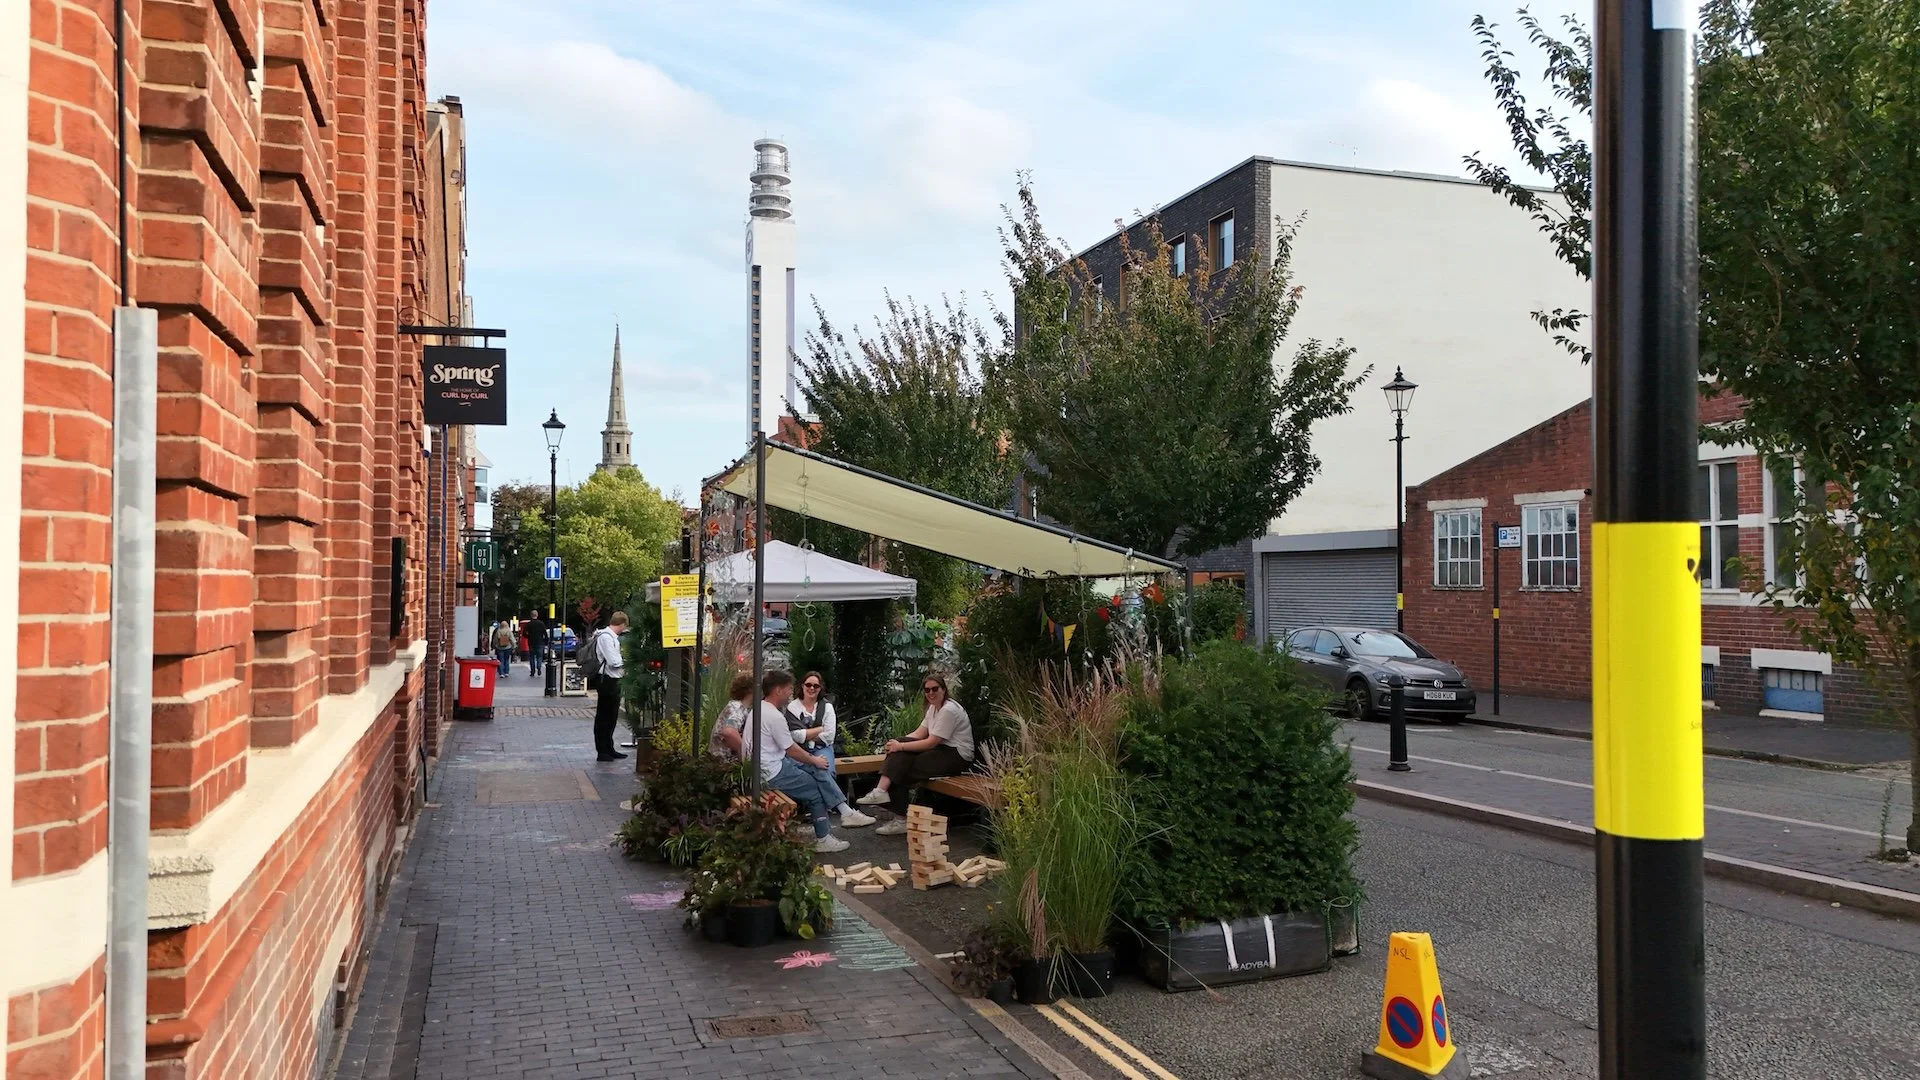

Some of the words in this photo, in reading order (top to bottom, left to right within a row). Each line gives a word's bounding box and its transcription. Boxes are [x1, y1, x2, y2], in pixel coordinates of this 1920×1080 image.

[429, 363, 500, 387] Spring
[441, 391, 460, 399] CURL
[460, 392, 470, 400] by
